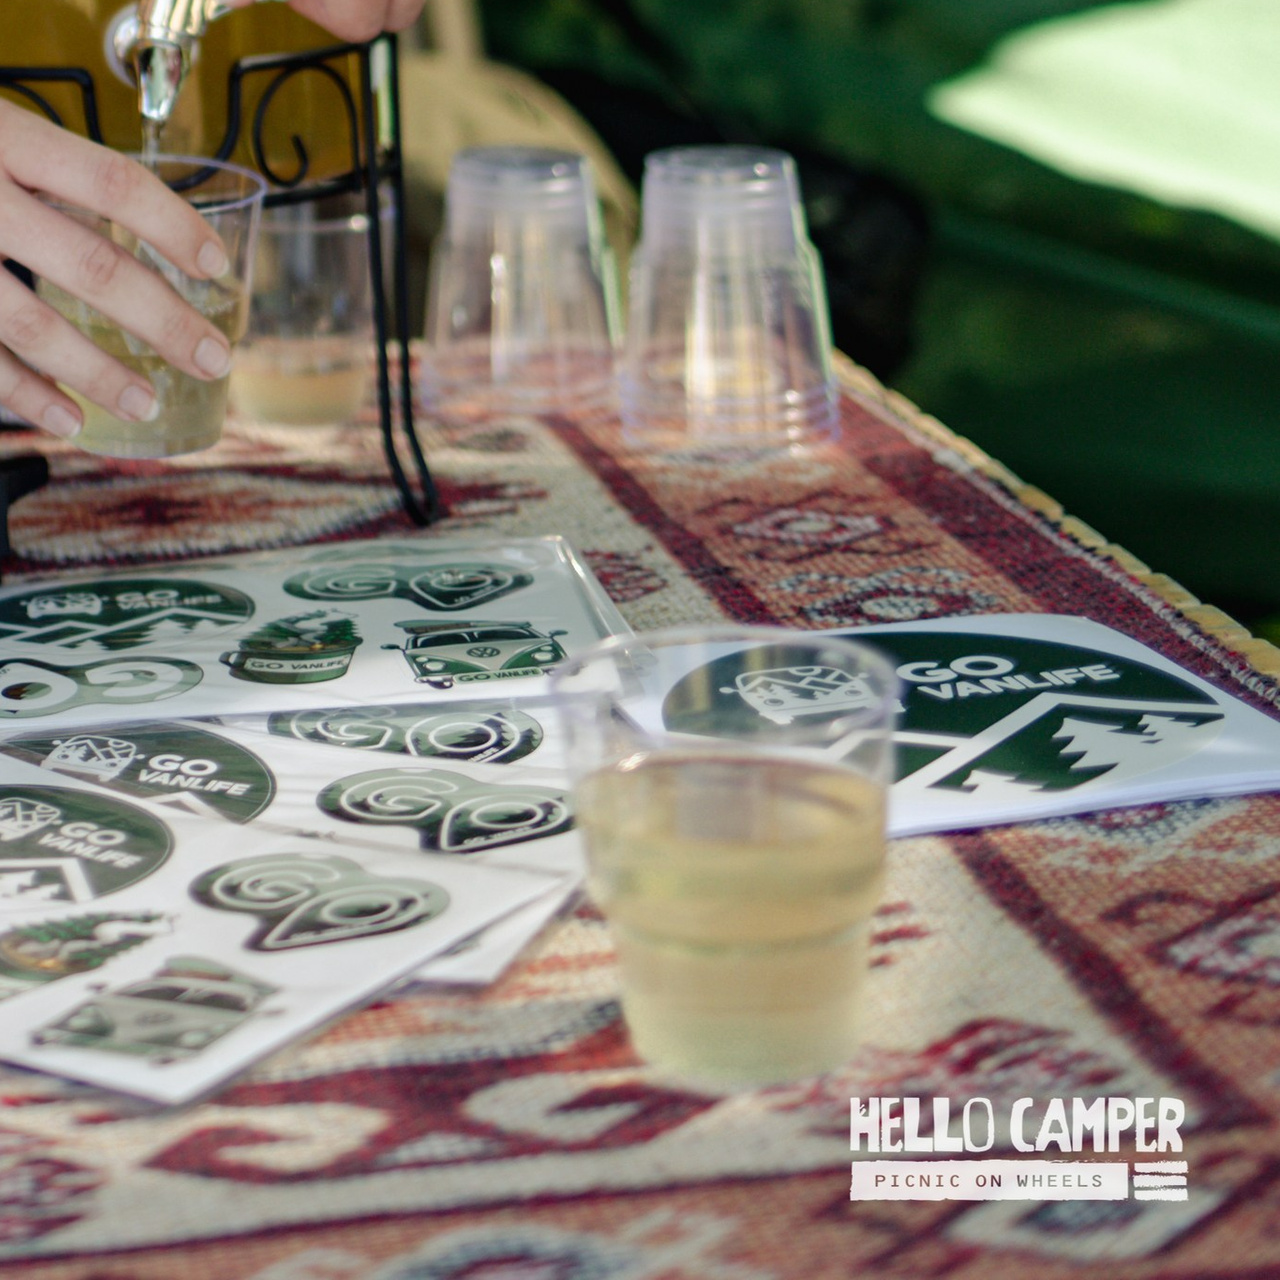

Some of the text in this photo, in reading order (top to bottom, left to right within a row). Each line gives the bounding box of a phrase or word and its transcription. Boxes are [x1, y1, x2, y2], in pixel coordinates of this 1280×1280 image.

[115, 590, 179, 602] GO
[251, 660, 344, 670] GO VANLIFE
[493, 668, 539, 678] VANLIFE
[895, 655, 1014, 683] GO
[917, 664, 1121, 700] VANLIFE
[148, 754, 218, 776] GO
[137, 768, 254, 796] VANLIFE
[59, 822, 126, 847] GO
[37, 833, 144, 869] VANLIFE
